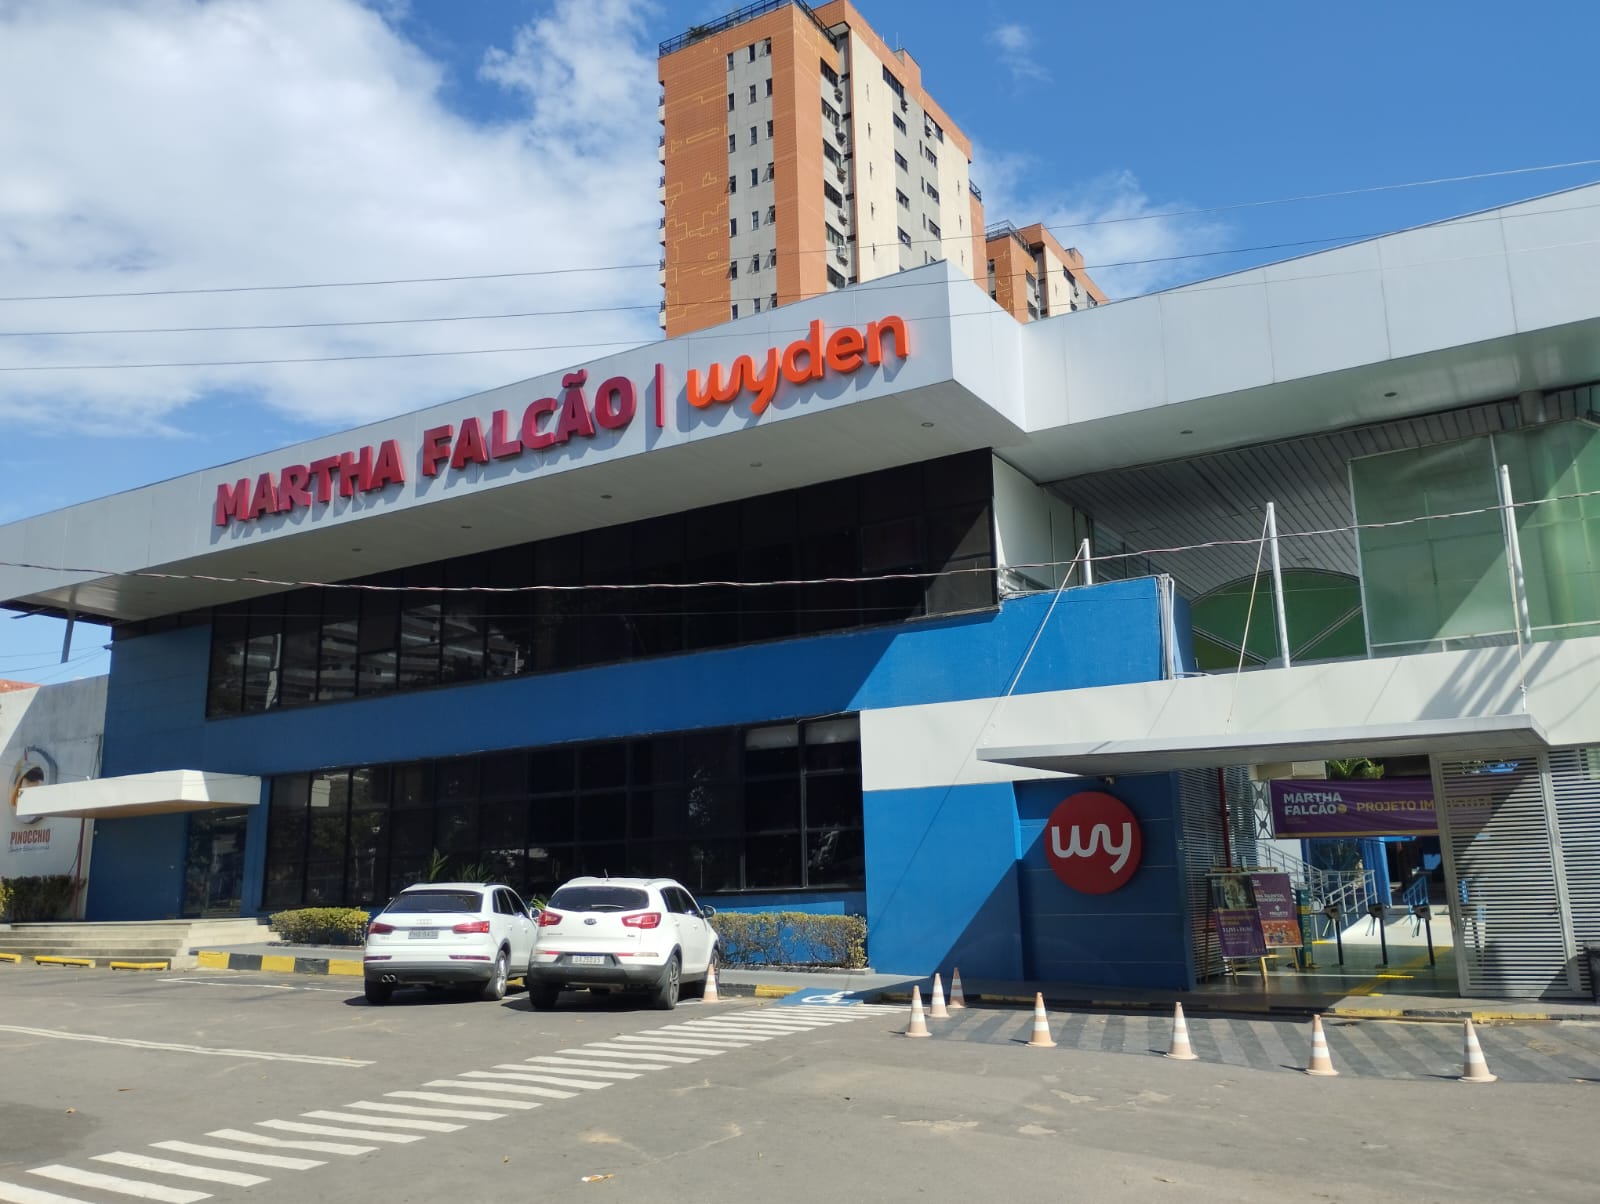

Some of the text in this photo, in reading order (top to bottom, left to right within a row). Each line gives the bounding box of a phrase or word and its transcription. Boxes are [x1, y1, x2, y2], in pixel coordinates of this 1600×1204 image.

[215, 314, 910, 527] MARTHA FALCÃO wyden
[1283, 792, 1342, 804] MARTHA
[1284, 801, 1337, 816] FALCÃO
[1356, 800, 1417, 812] PROJETO
[9, 828, 51, 845] PINOCCHIO
